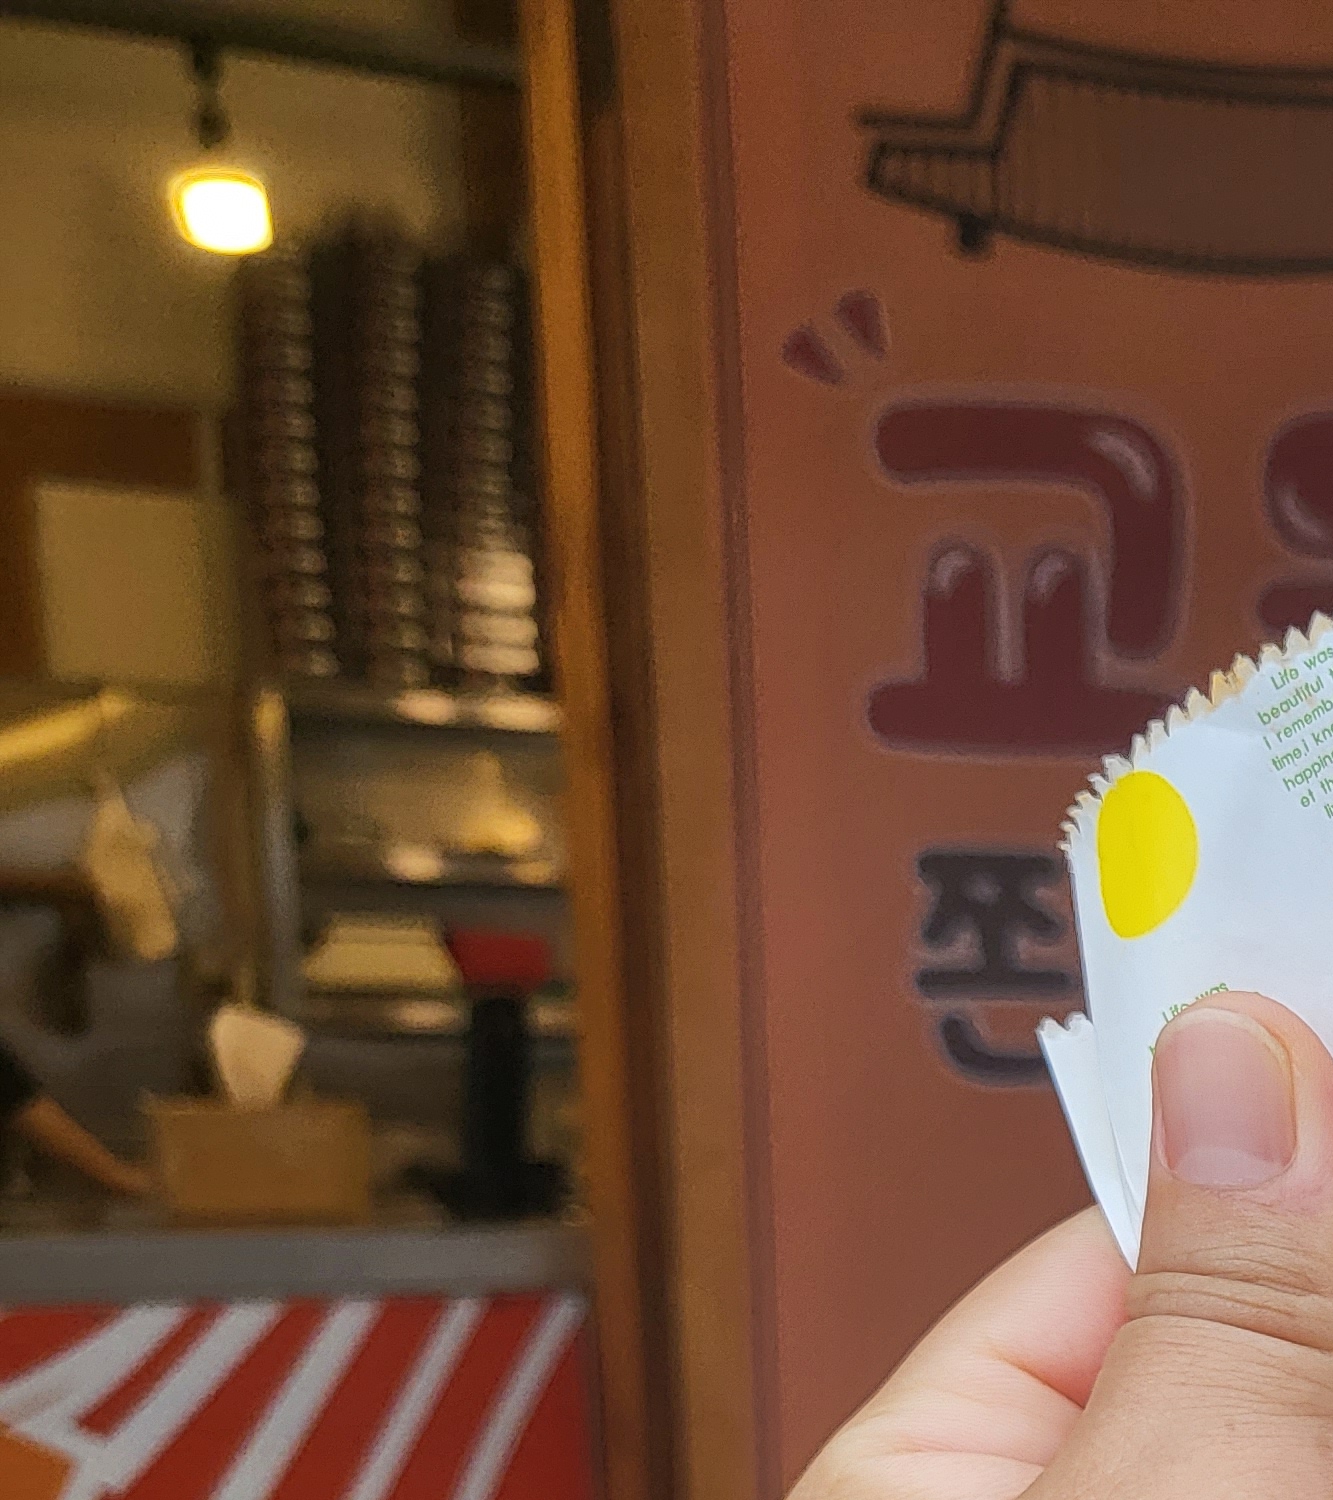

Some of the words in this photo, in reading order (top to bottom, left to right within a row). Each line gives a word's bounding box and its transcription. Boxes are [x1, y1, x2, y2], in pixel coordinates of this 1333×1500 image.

[1270, 668, 1300, 691] Life
[1256, 675, 1325, 726] beautiful
[1300, 788, 1316, 808] et
